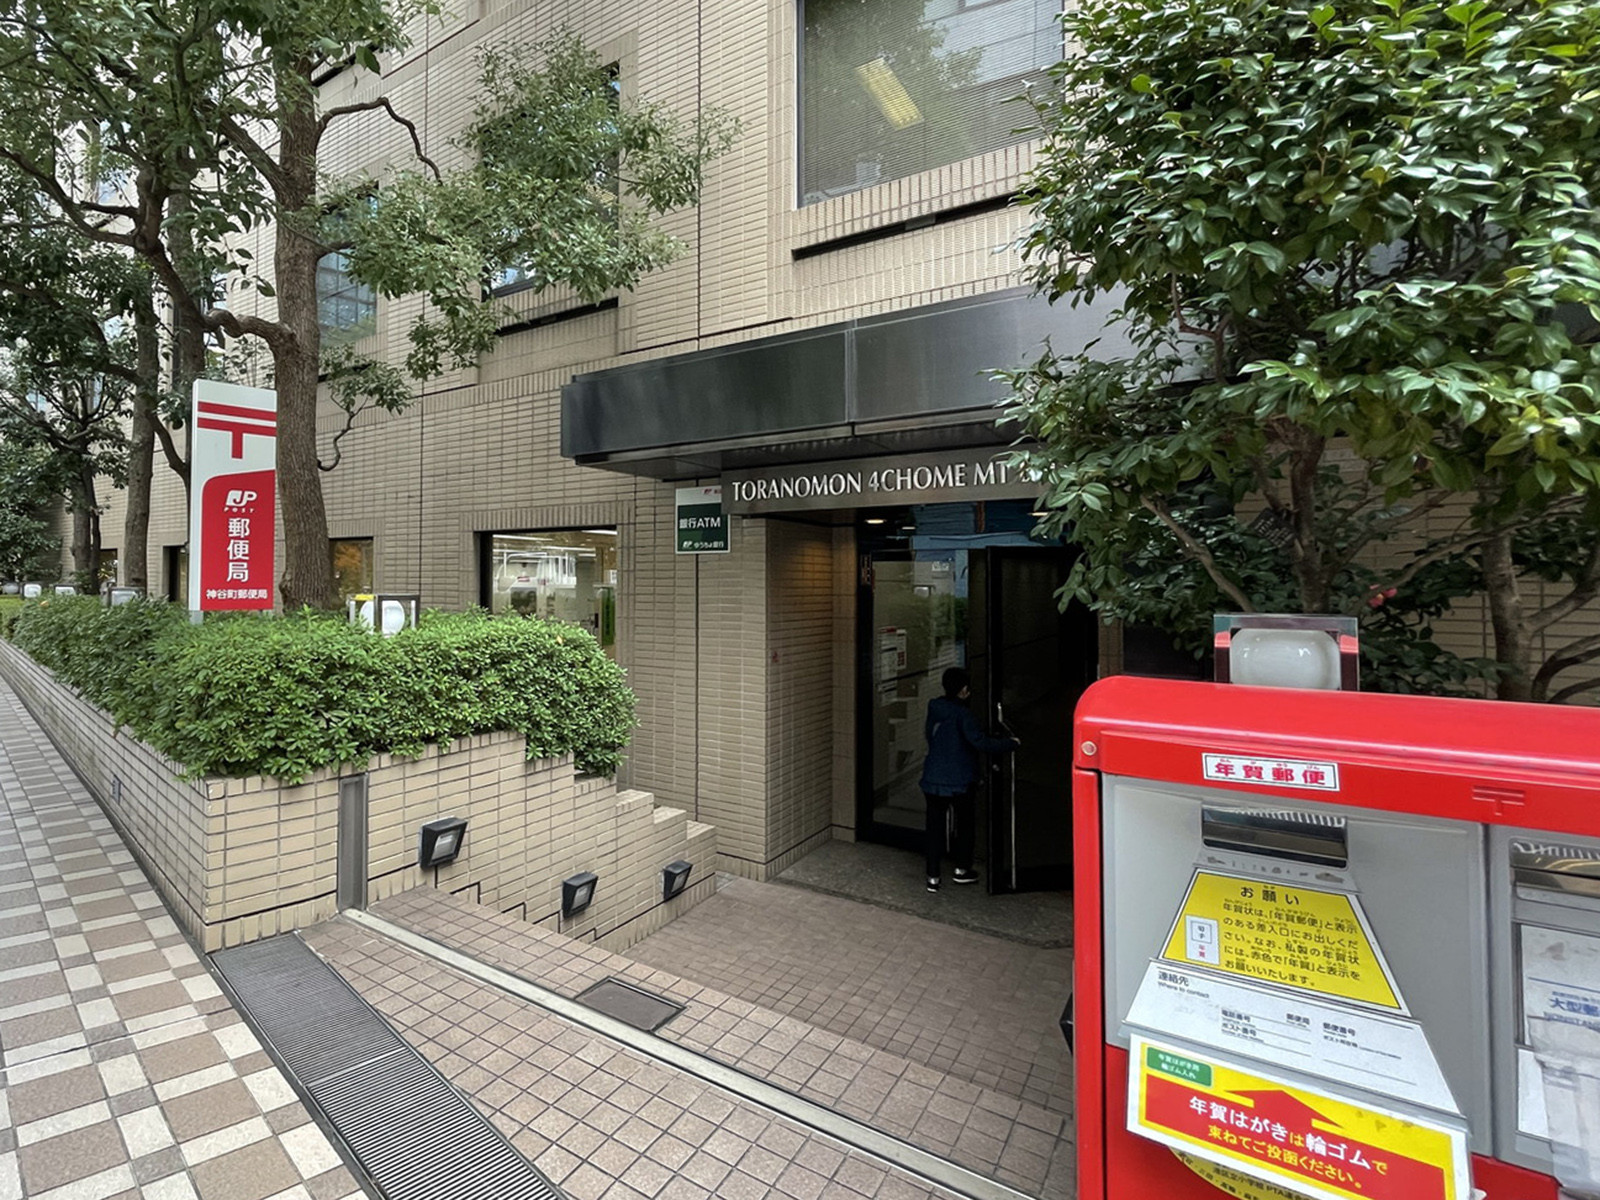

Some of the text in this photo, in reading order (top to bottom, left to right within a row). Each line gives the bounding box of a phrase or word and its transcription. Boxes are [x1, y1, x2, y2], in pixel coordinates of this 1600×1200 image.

[732, 472, 862, 501] TORANOMON
[868, 463, 966, 492] 4CHOME
[974, 460, 1009, 486] MT
[227, 518, 250, 583] 郵便局
[206, 589, 268, 599] 神谷町郵便局
[1214, 763, 1326, 786] 年賀郵便
[1240, 886, 1300, 906] お願い
[1189, 1096, 1388, 1175] 年賀はがきは輪ゴムで
[1208, 1124, 1363, 1189] 束ねてご投函ください。
